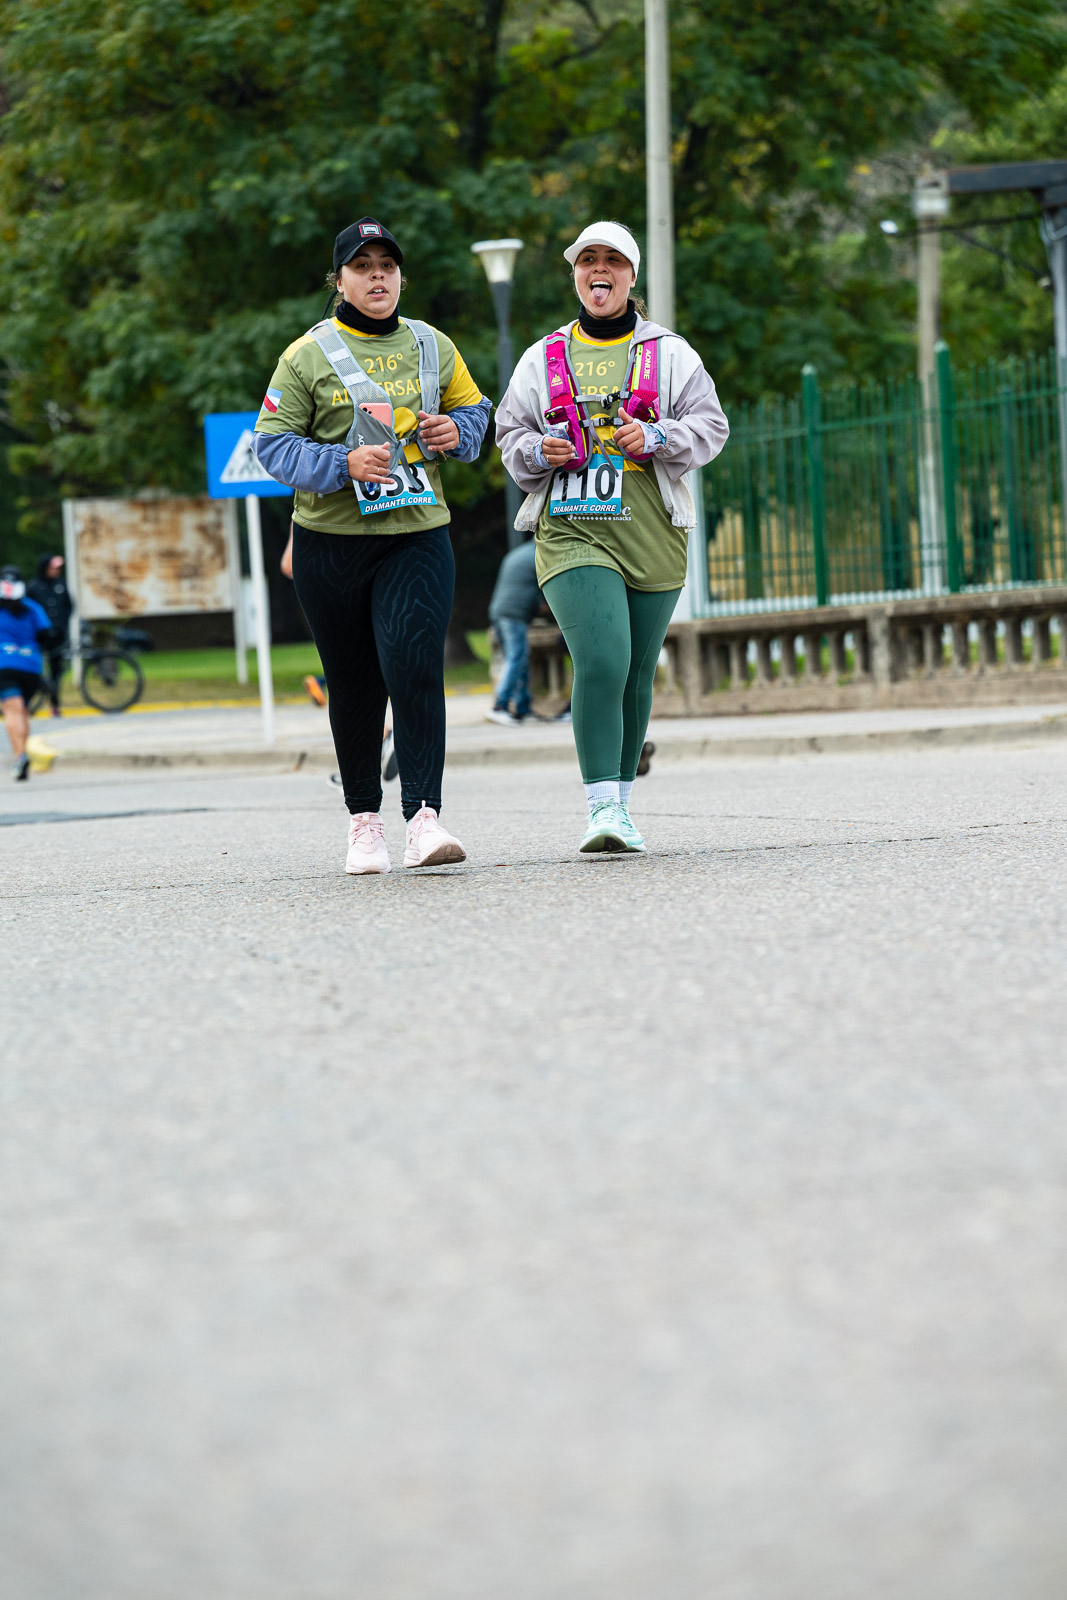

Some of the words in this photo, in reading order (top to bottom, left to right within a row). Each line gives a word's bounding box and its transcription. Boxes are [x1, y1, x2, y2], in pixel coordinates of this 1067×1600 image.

[558, 463, 616, 502] 110
[364, 497, 406, 513] DIAMANTE
[407, 496, 433, 504] CORRE
[552, 504, 589, 514] DIAMANTE
[589, 504, 617, 512] CORRE
